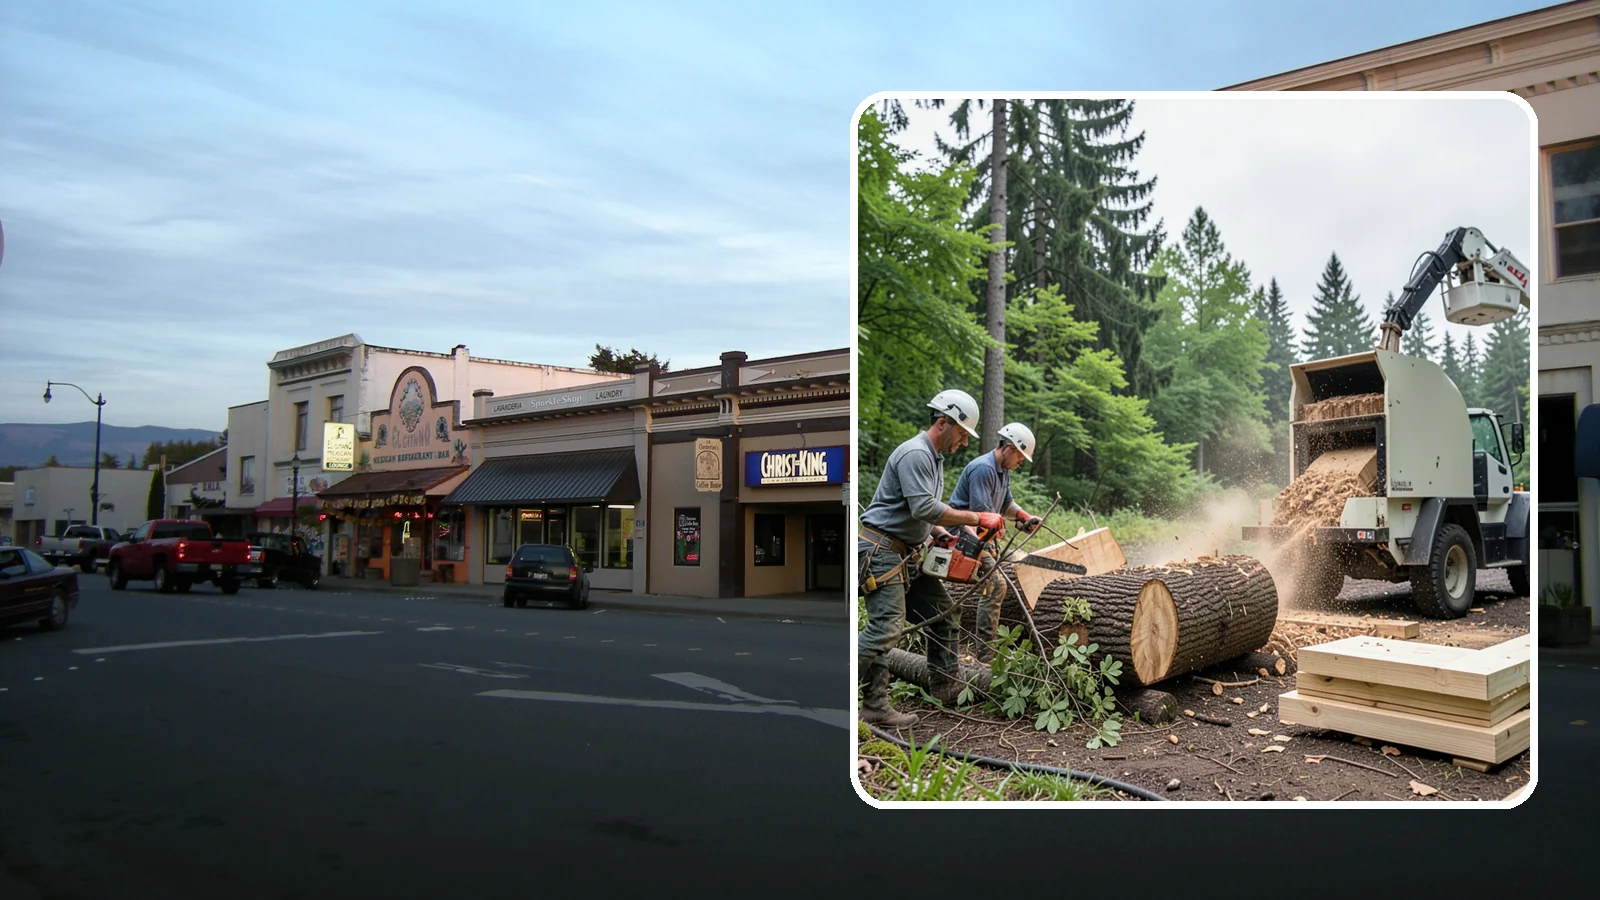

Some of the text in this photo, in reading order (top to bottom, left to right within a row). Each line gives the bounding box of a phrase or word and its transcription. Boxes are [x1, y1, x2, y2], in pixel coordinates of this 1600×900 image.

[530, 393, 582, 409] Sparkle Shop
[595, 388, 624, 400] LAUNDRY
[493, 402, 523, 413] LAVANDERIA
[391, 425, 402, 449] EL
[373, 454, 397, 465] MEXICAN
[397, 451, 433, 463] RESTAURANT
[437, 450, 450, 459] BAR
[760, 449, 827, 478] CHRIST KING
[696, 480, 722, 489] Coffee House
